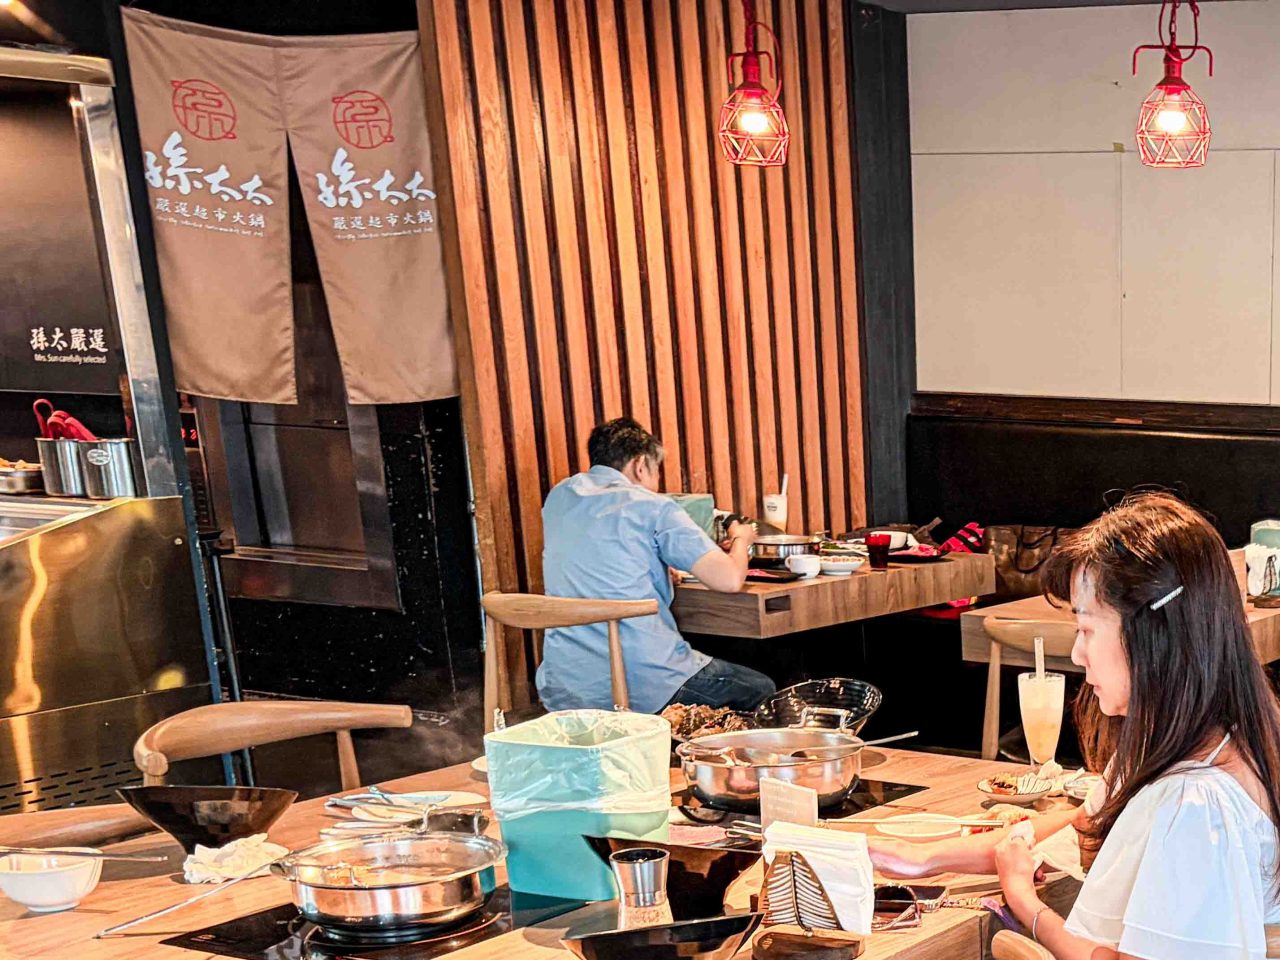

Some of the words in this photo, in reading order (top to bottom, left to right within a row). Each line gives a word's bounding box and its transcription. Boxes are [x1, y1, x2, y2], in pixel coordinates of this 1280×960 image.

[145, 131, 274, 206] 孫太太
[316, 147, 437, 209] 孫太太
[155, 197, 266, 229] 嚴選超市火鍋
[332, 209, 434, 231] 嚴選超市火鍋
[30, 326, 109, 353] 孫太嚴選
